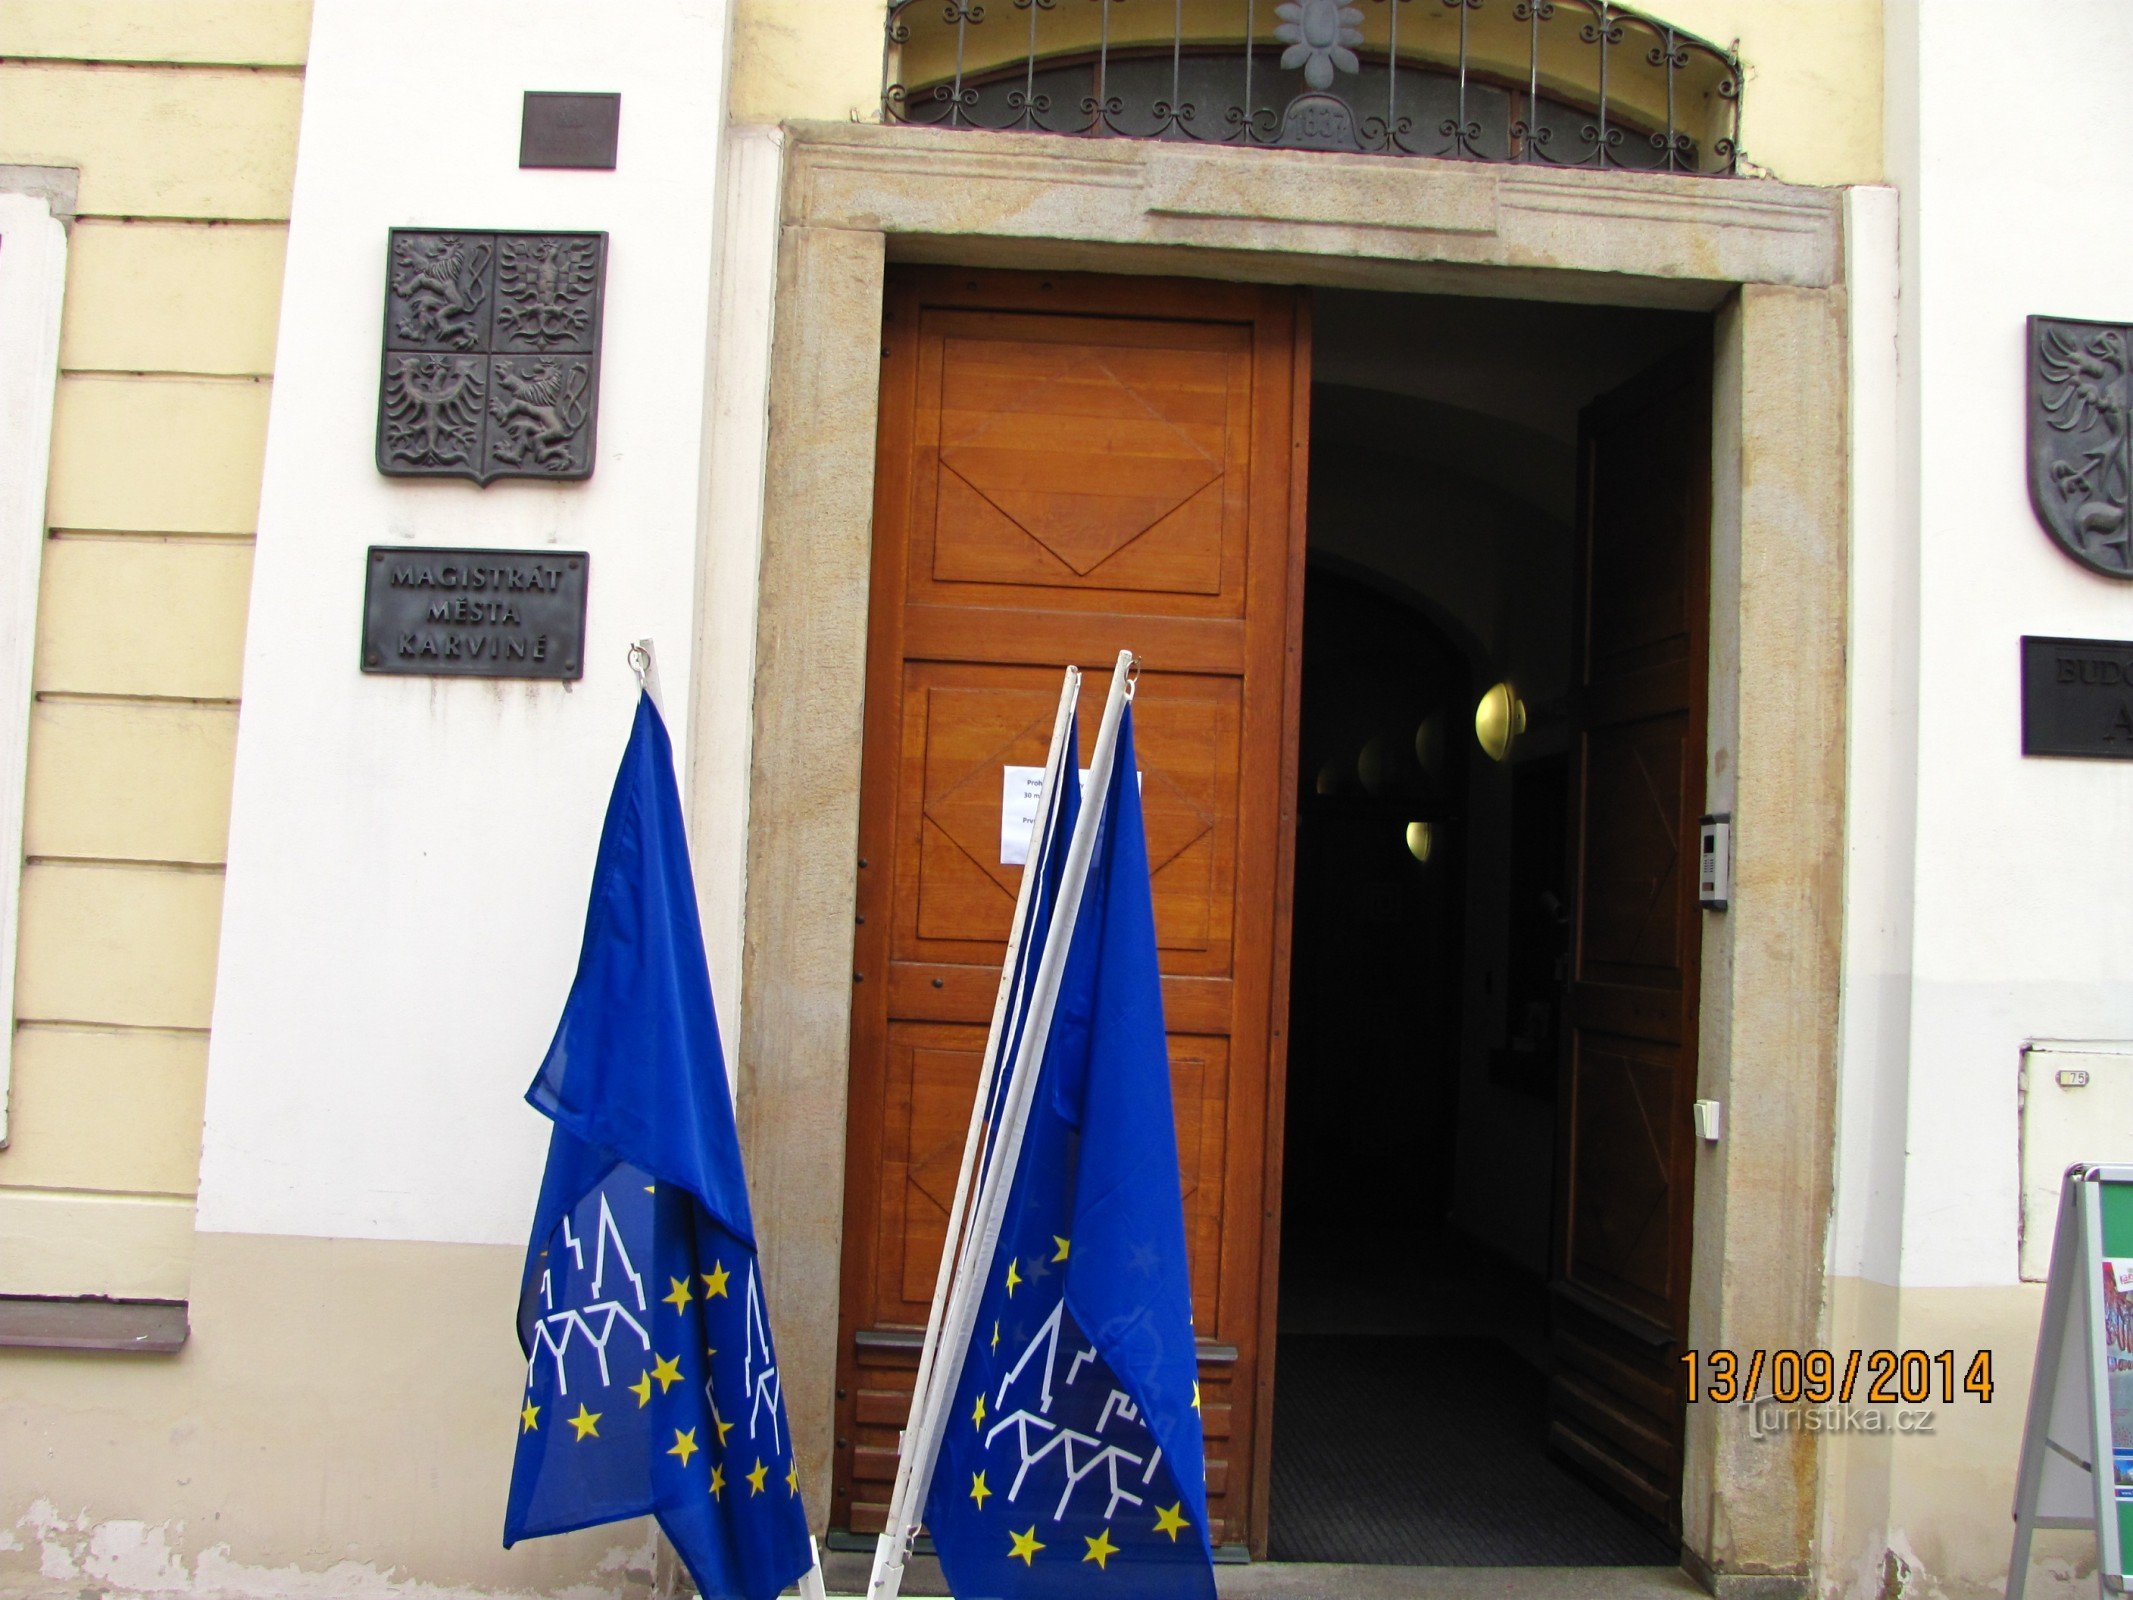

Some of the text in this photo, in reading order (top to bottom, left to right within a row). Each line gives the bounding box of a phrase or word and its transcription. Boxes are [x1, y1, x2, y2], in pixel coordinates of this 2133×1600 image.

[391, 565, 563, 590] MAGISTRÁT
[427, 598, 521, 625] MĚSTA
[399, 634, 547, 661] KARVINÉ
